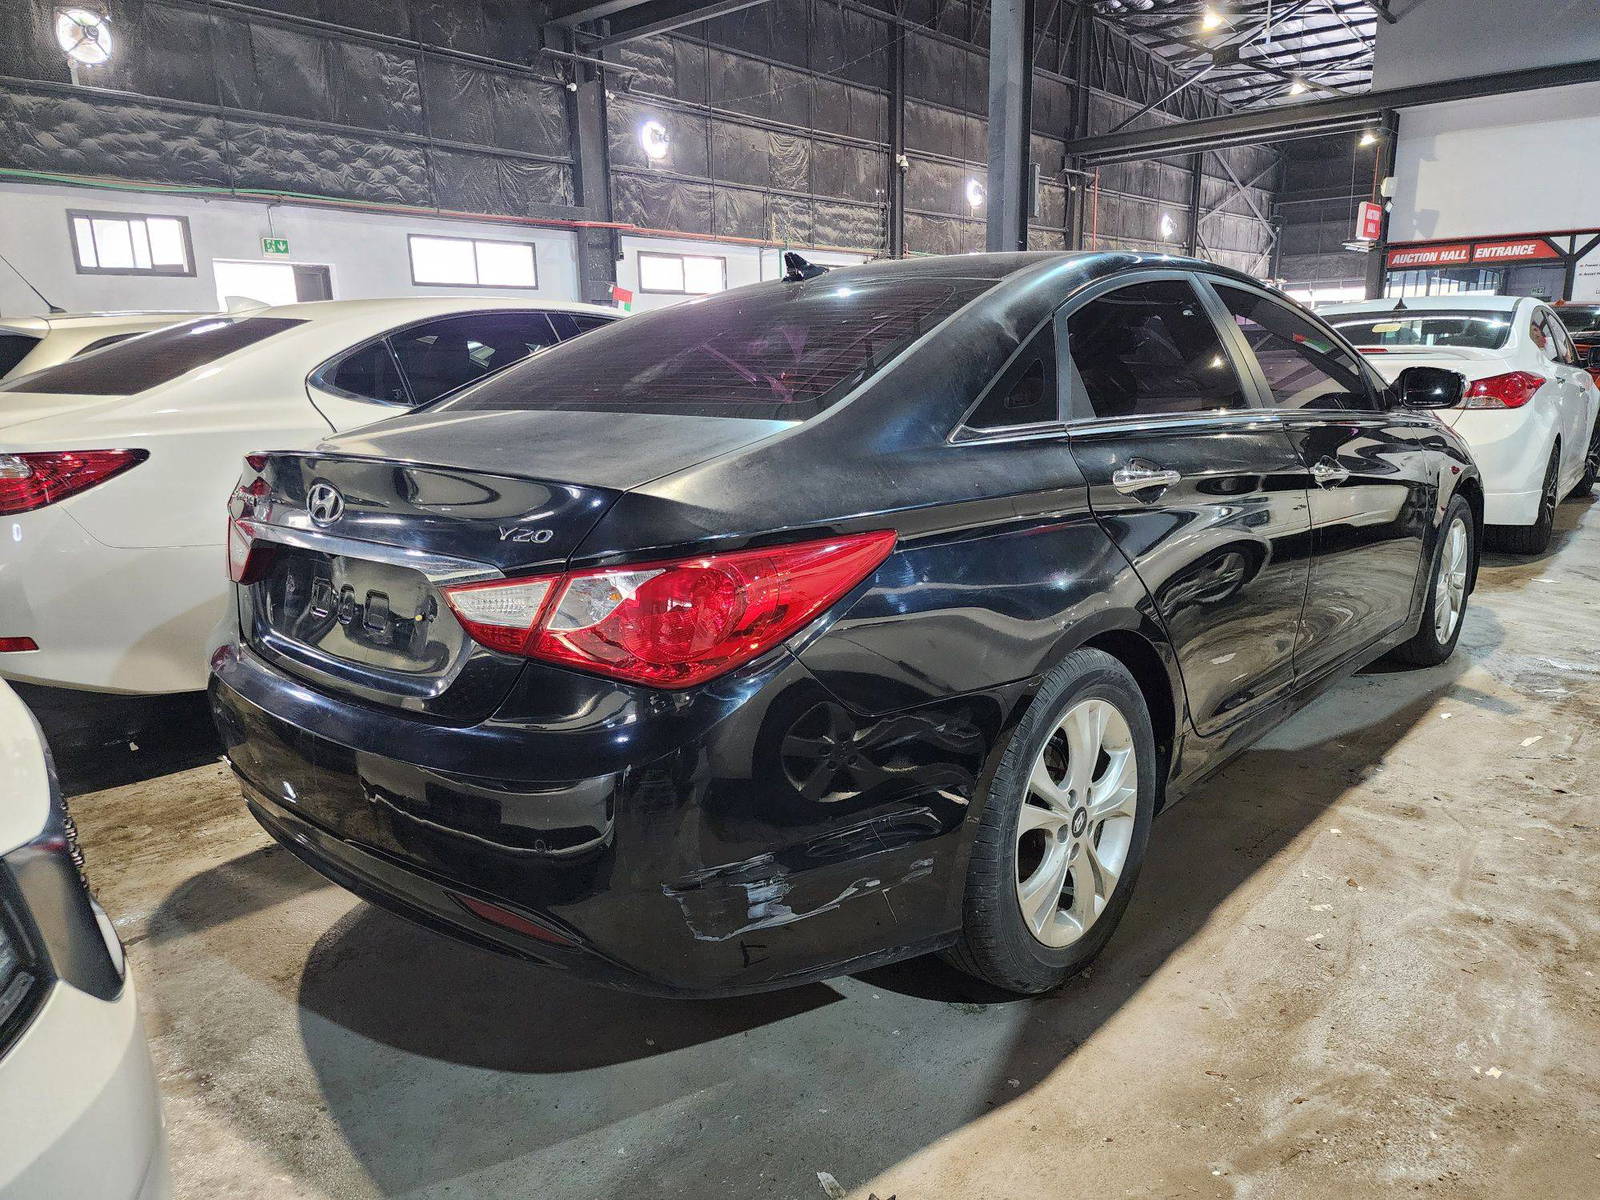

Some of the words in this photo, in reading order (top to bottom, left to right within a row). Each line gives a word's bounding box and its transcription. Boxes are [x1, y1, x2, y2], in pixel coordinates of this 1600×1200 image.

[1391, 250, 1438, 264] AUCTION
[1440, 250, 1467, 260] HALL
[1474, 244, 1536, 258] ENTRANCE
[499, 526, 554, 543] Y20
